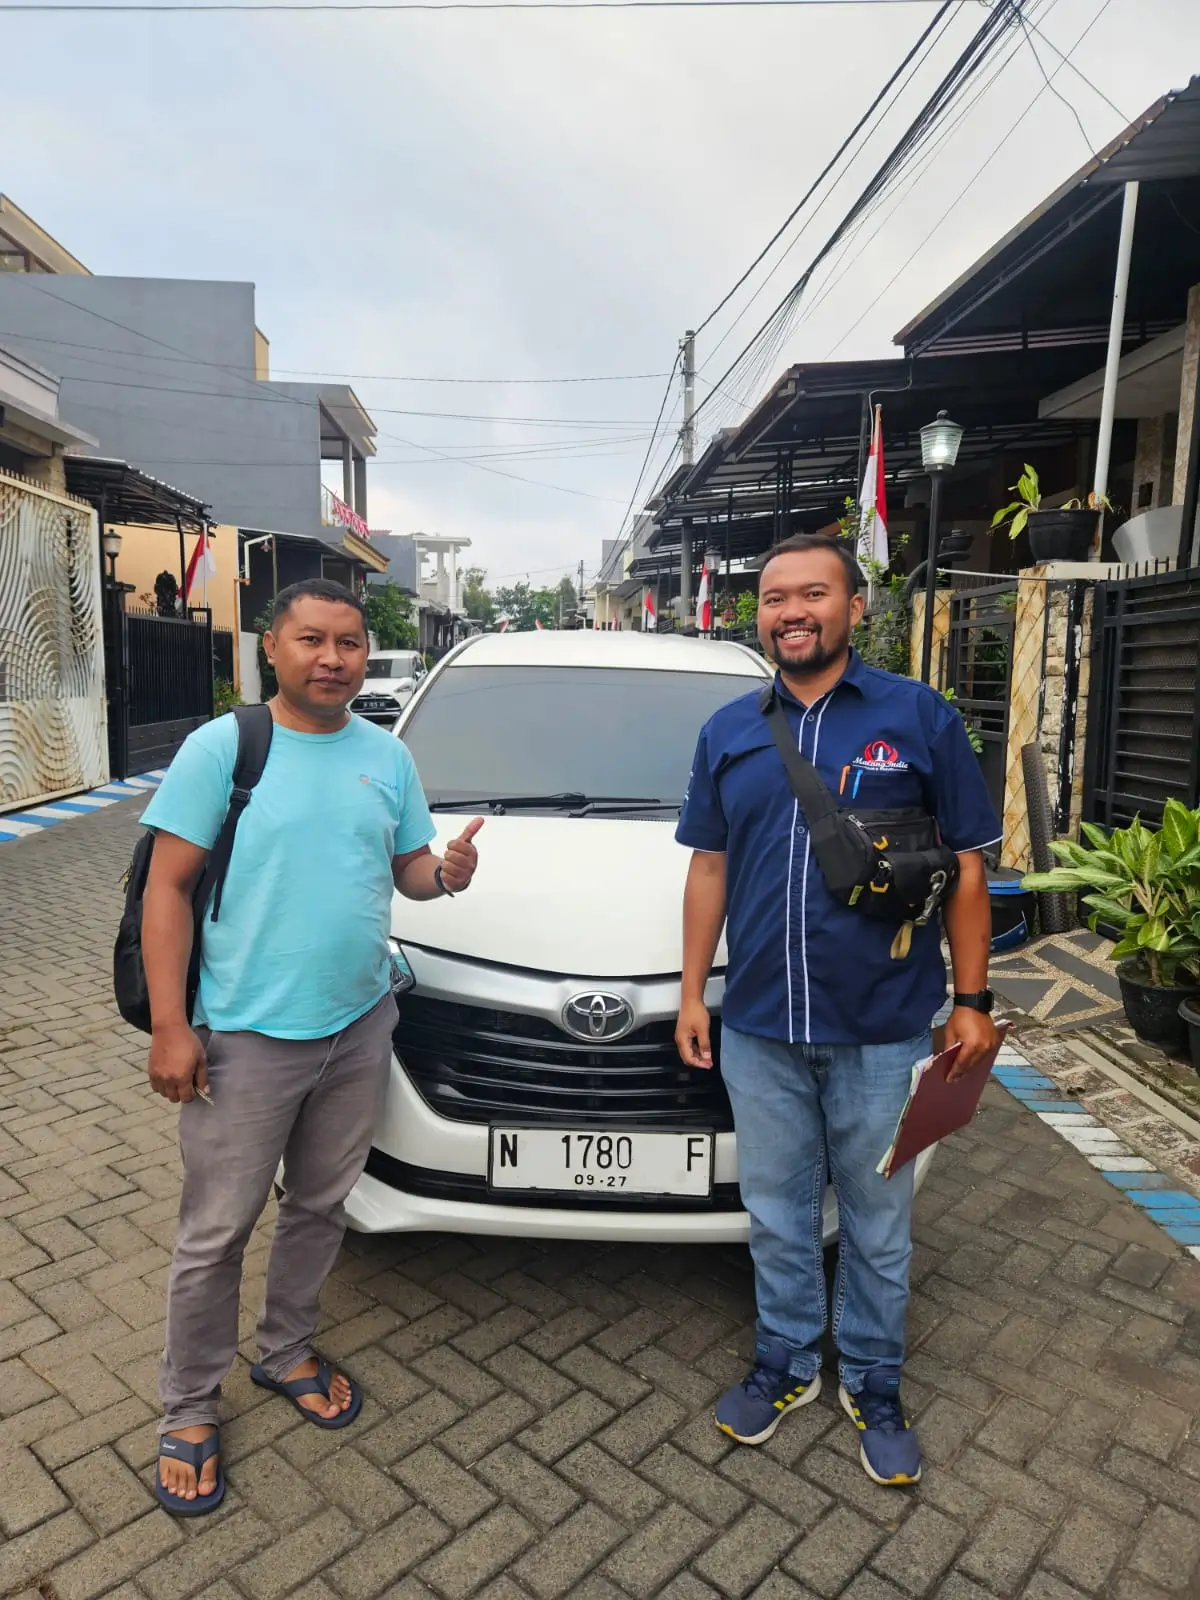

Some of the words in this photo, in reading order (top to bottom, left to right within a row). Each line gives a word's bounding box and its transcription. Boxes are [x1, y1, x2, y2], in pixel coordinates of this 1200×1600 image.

[500, 1134, 518, 1167] N
[561, 1135, 632, 1169] 1780
[686, 1137, 704, 1171] F
